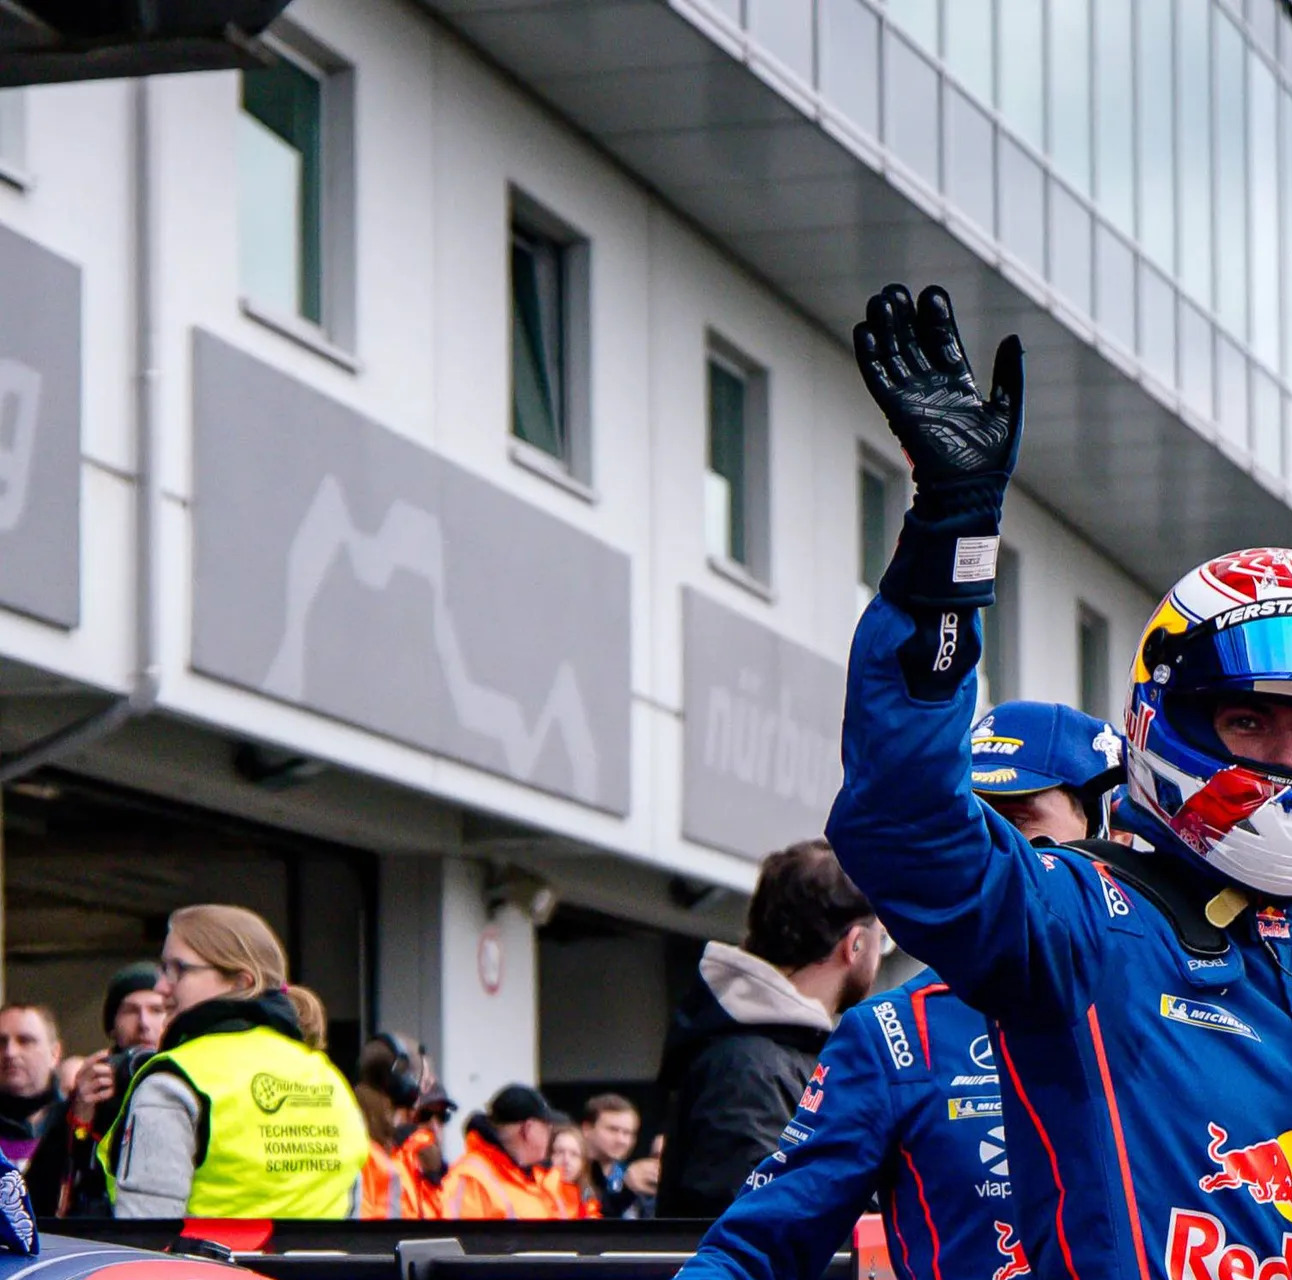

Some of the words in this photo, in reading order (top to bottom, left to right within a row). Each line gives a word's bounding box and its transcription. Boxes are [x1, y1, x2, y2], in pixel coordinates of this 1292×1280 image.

[872, 1000, 914, 1070] sparco
[258, 1124, 340, 1138] TECHNISCHER
[264, 1142, 339, 1155] KOMMISSAR
[266, 1159, 342, 1173] SCRUTINEER
